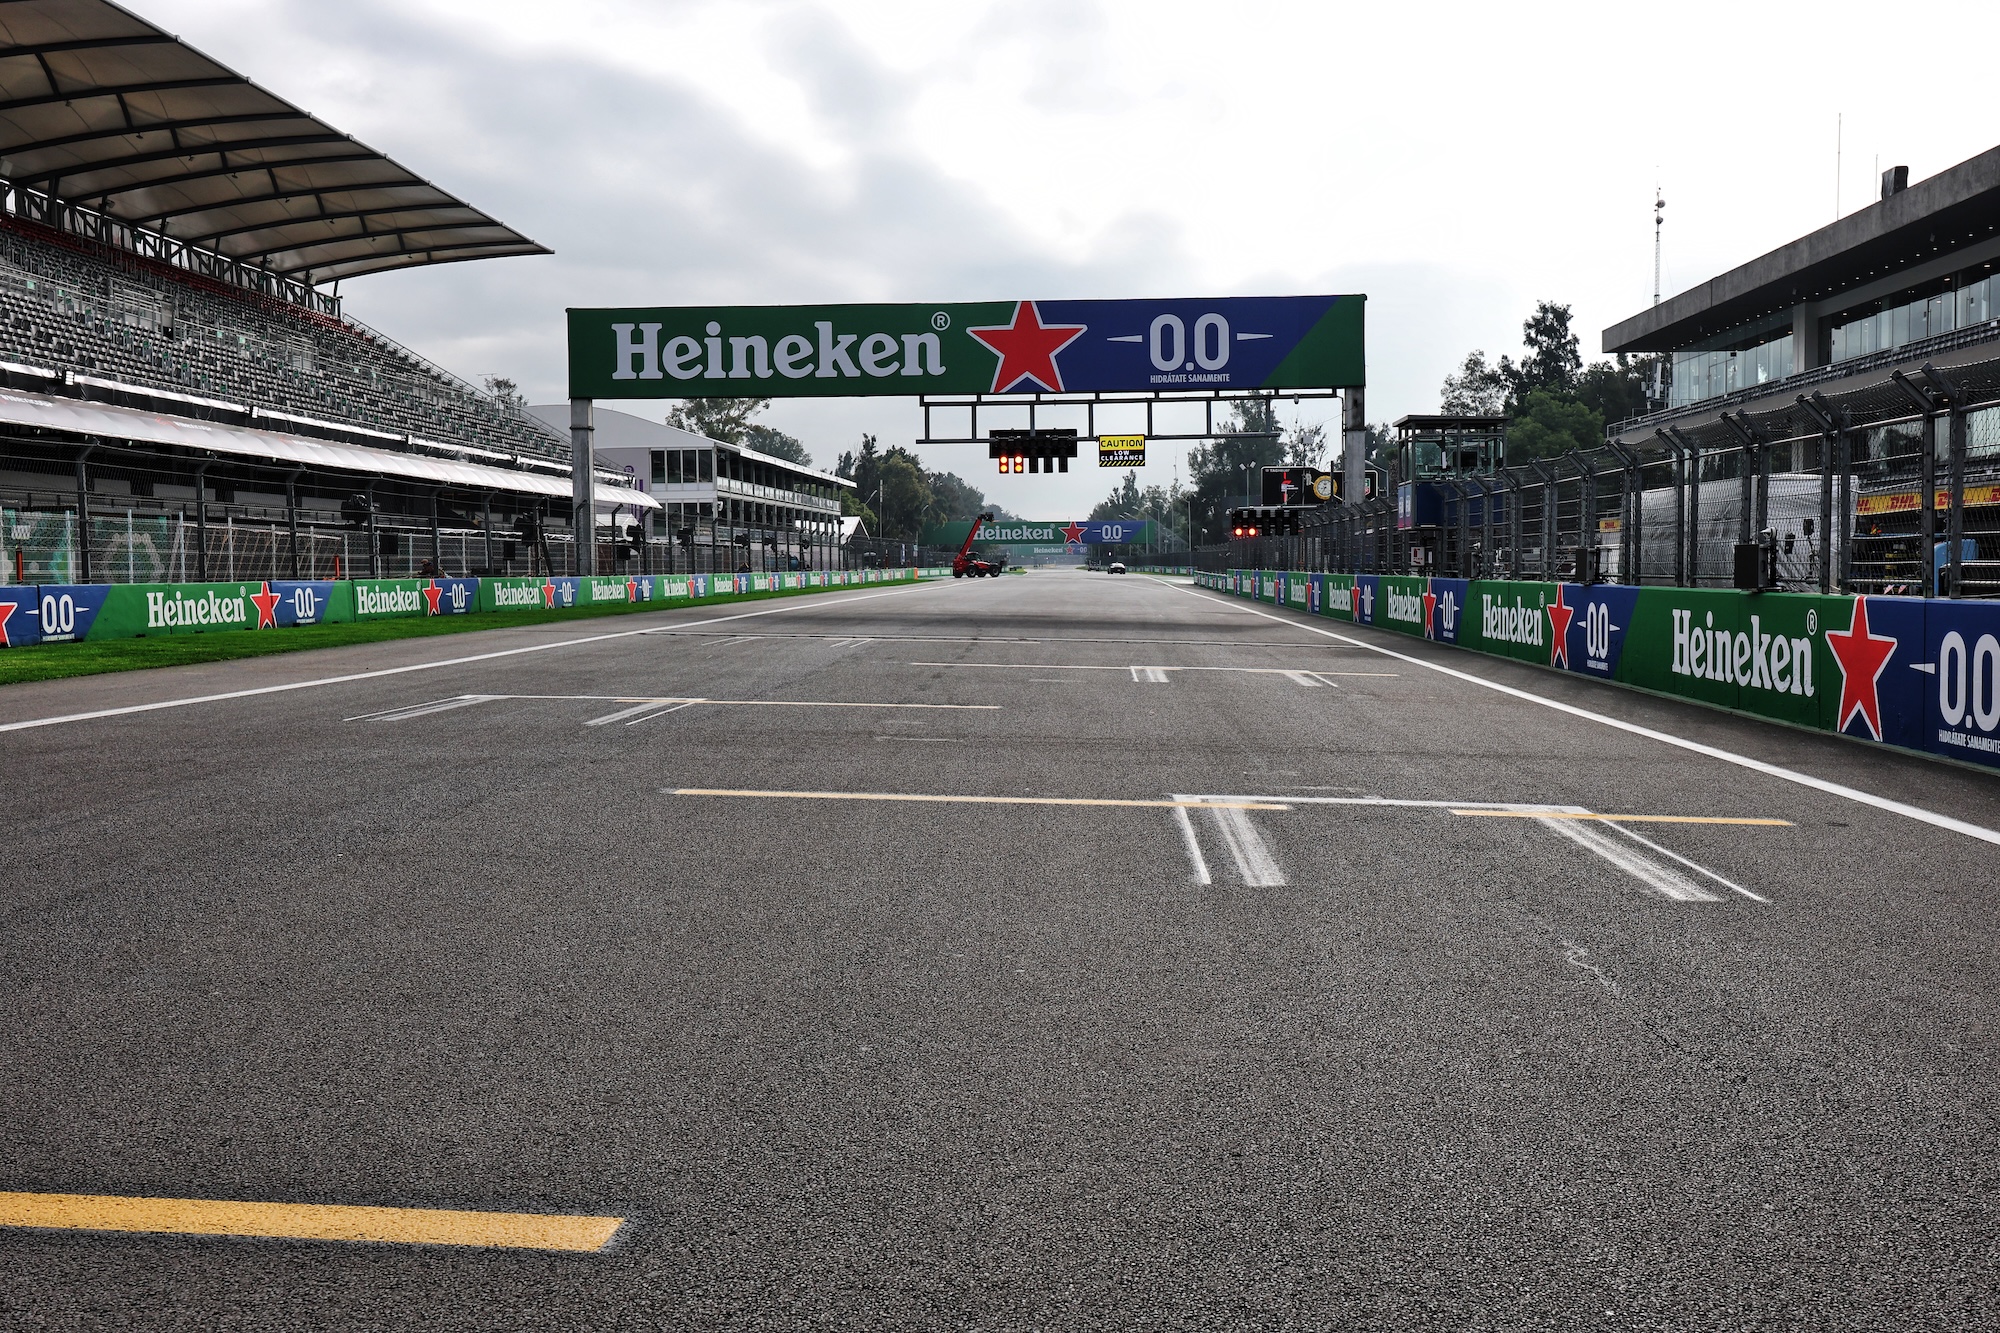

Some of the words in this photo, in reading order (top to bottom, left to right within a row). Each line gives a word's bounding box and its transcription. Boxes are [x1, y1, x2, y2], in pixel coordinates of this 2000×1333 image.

[611, 321, 946, 380] Heineken
[1150, 313, 1230, 371] 0.0
[1150, 373, 1187, 383] HIDRÁTATE
[1188, 373, 1230, 383] SANAMENTE
[1102, 525, 1122, 539] 0.0
[295, 587, 315, 618] 0.0
[356, 585, 420, 614] Heineken
[452, 583, 466, 608] 0.0
[494, 582, 540, 606] Heineken
[592, 580, 625, 600] Heineken
[1387, 585, 1421, 623] Heineken
[42, 594, 74, 634] 0.0
[147, 591, 246, 627] Heineken
[1443, 590, 1454, 630] 0.0
[1482, 594, 1543, 646] Heineken
[1587, 602, 1608, 659] 0.0
[1672, 608, 1815, 698] Heineken
[1940, 630, 2000, 732] 0.0
[1938, 728, 1966, 747] HIDRÁTATE
